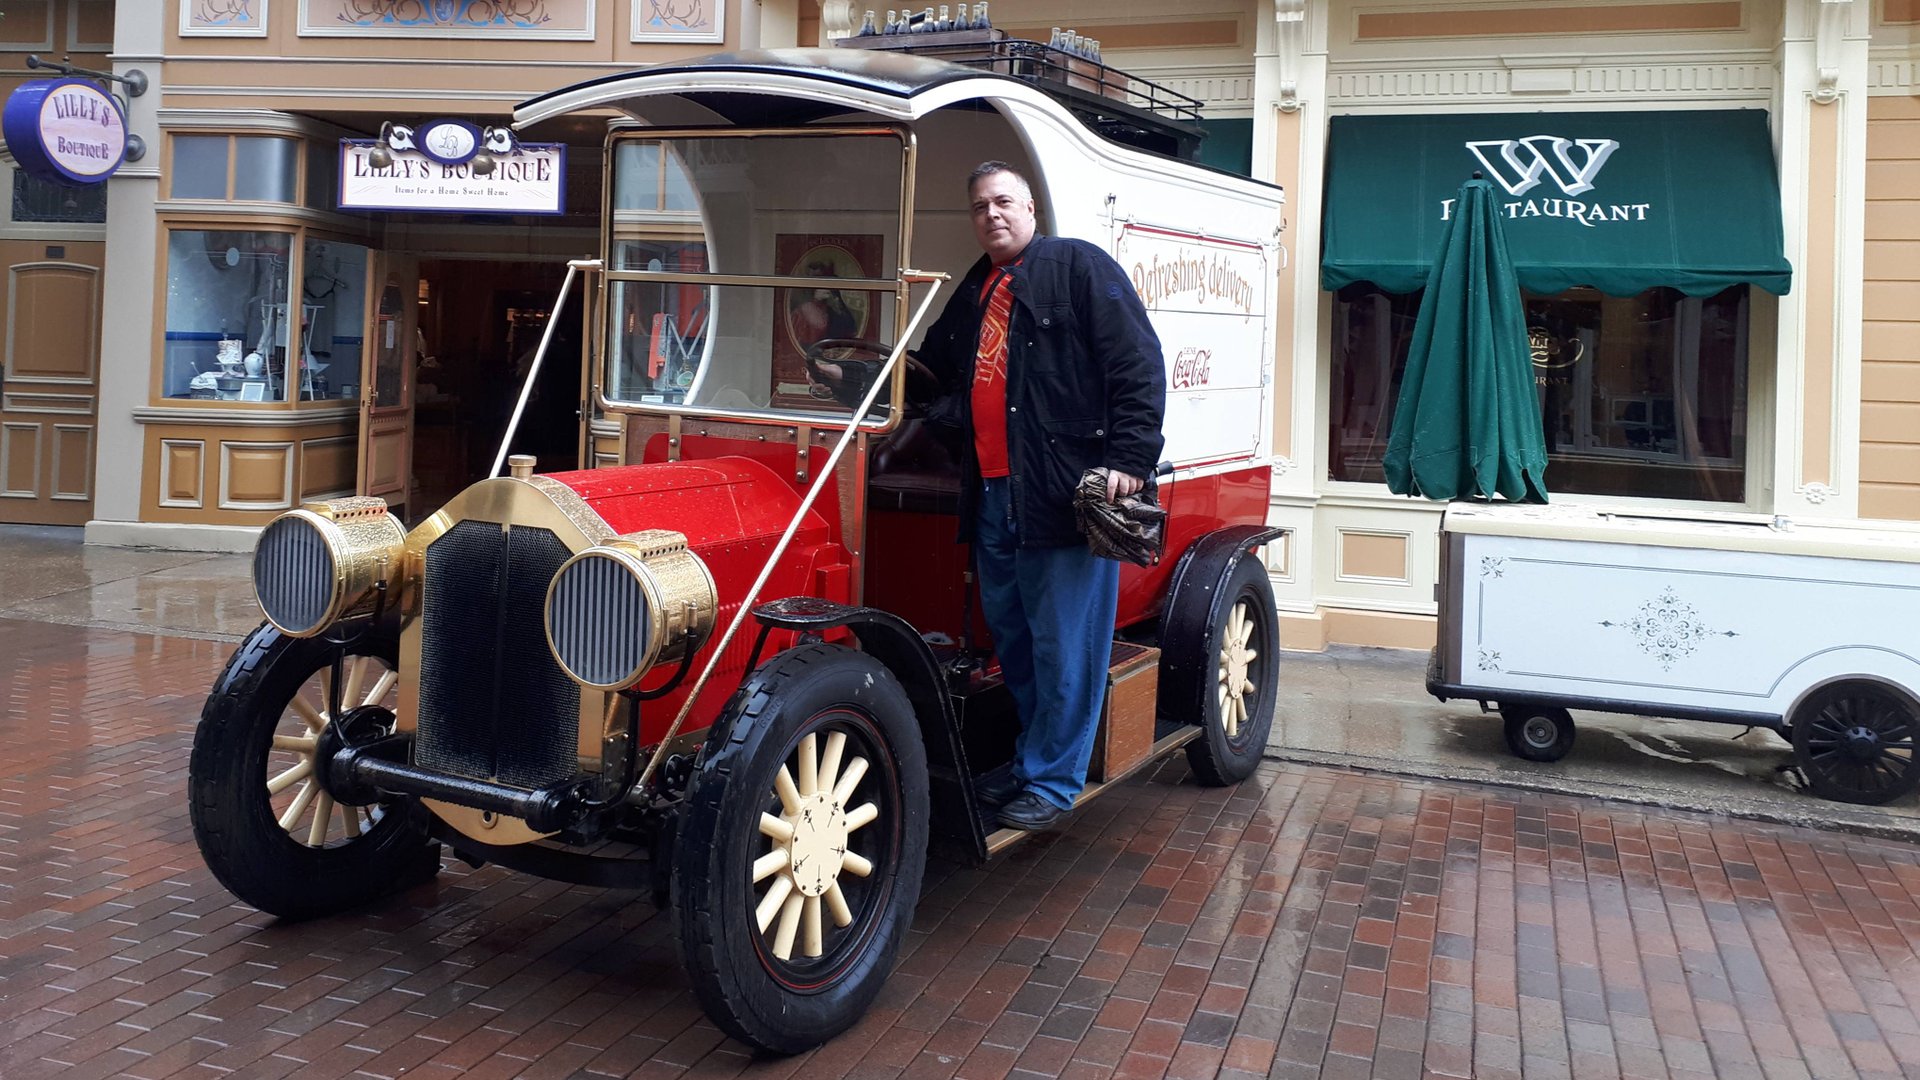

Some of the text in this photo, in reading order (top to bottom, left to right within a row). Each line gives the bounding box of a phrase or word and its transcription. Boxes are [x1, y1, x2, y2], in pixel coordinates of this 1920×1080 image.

[53, 93, 110, 127] LILLY'S
[57, 136, 109, 160] BOUTIQUE
[395, 185, 414, 194] Items
[417, 186, 427, 194] for
[438, 186, 459, 195] Home
[462, 187, 484, 196] Sweet
[487, 188, 509, 197] Home
[1440, 198, 1650, 227] TAURANT
[1133, 247, 1254, 324] Refreshing delivery
